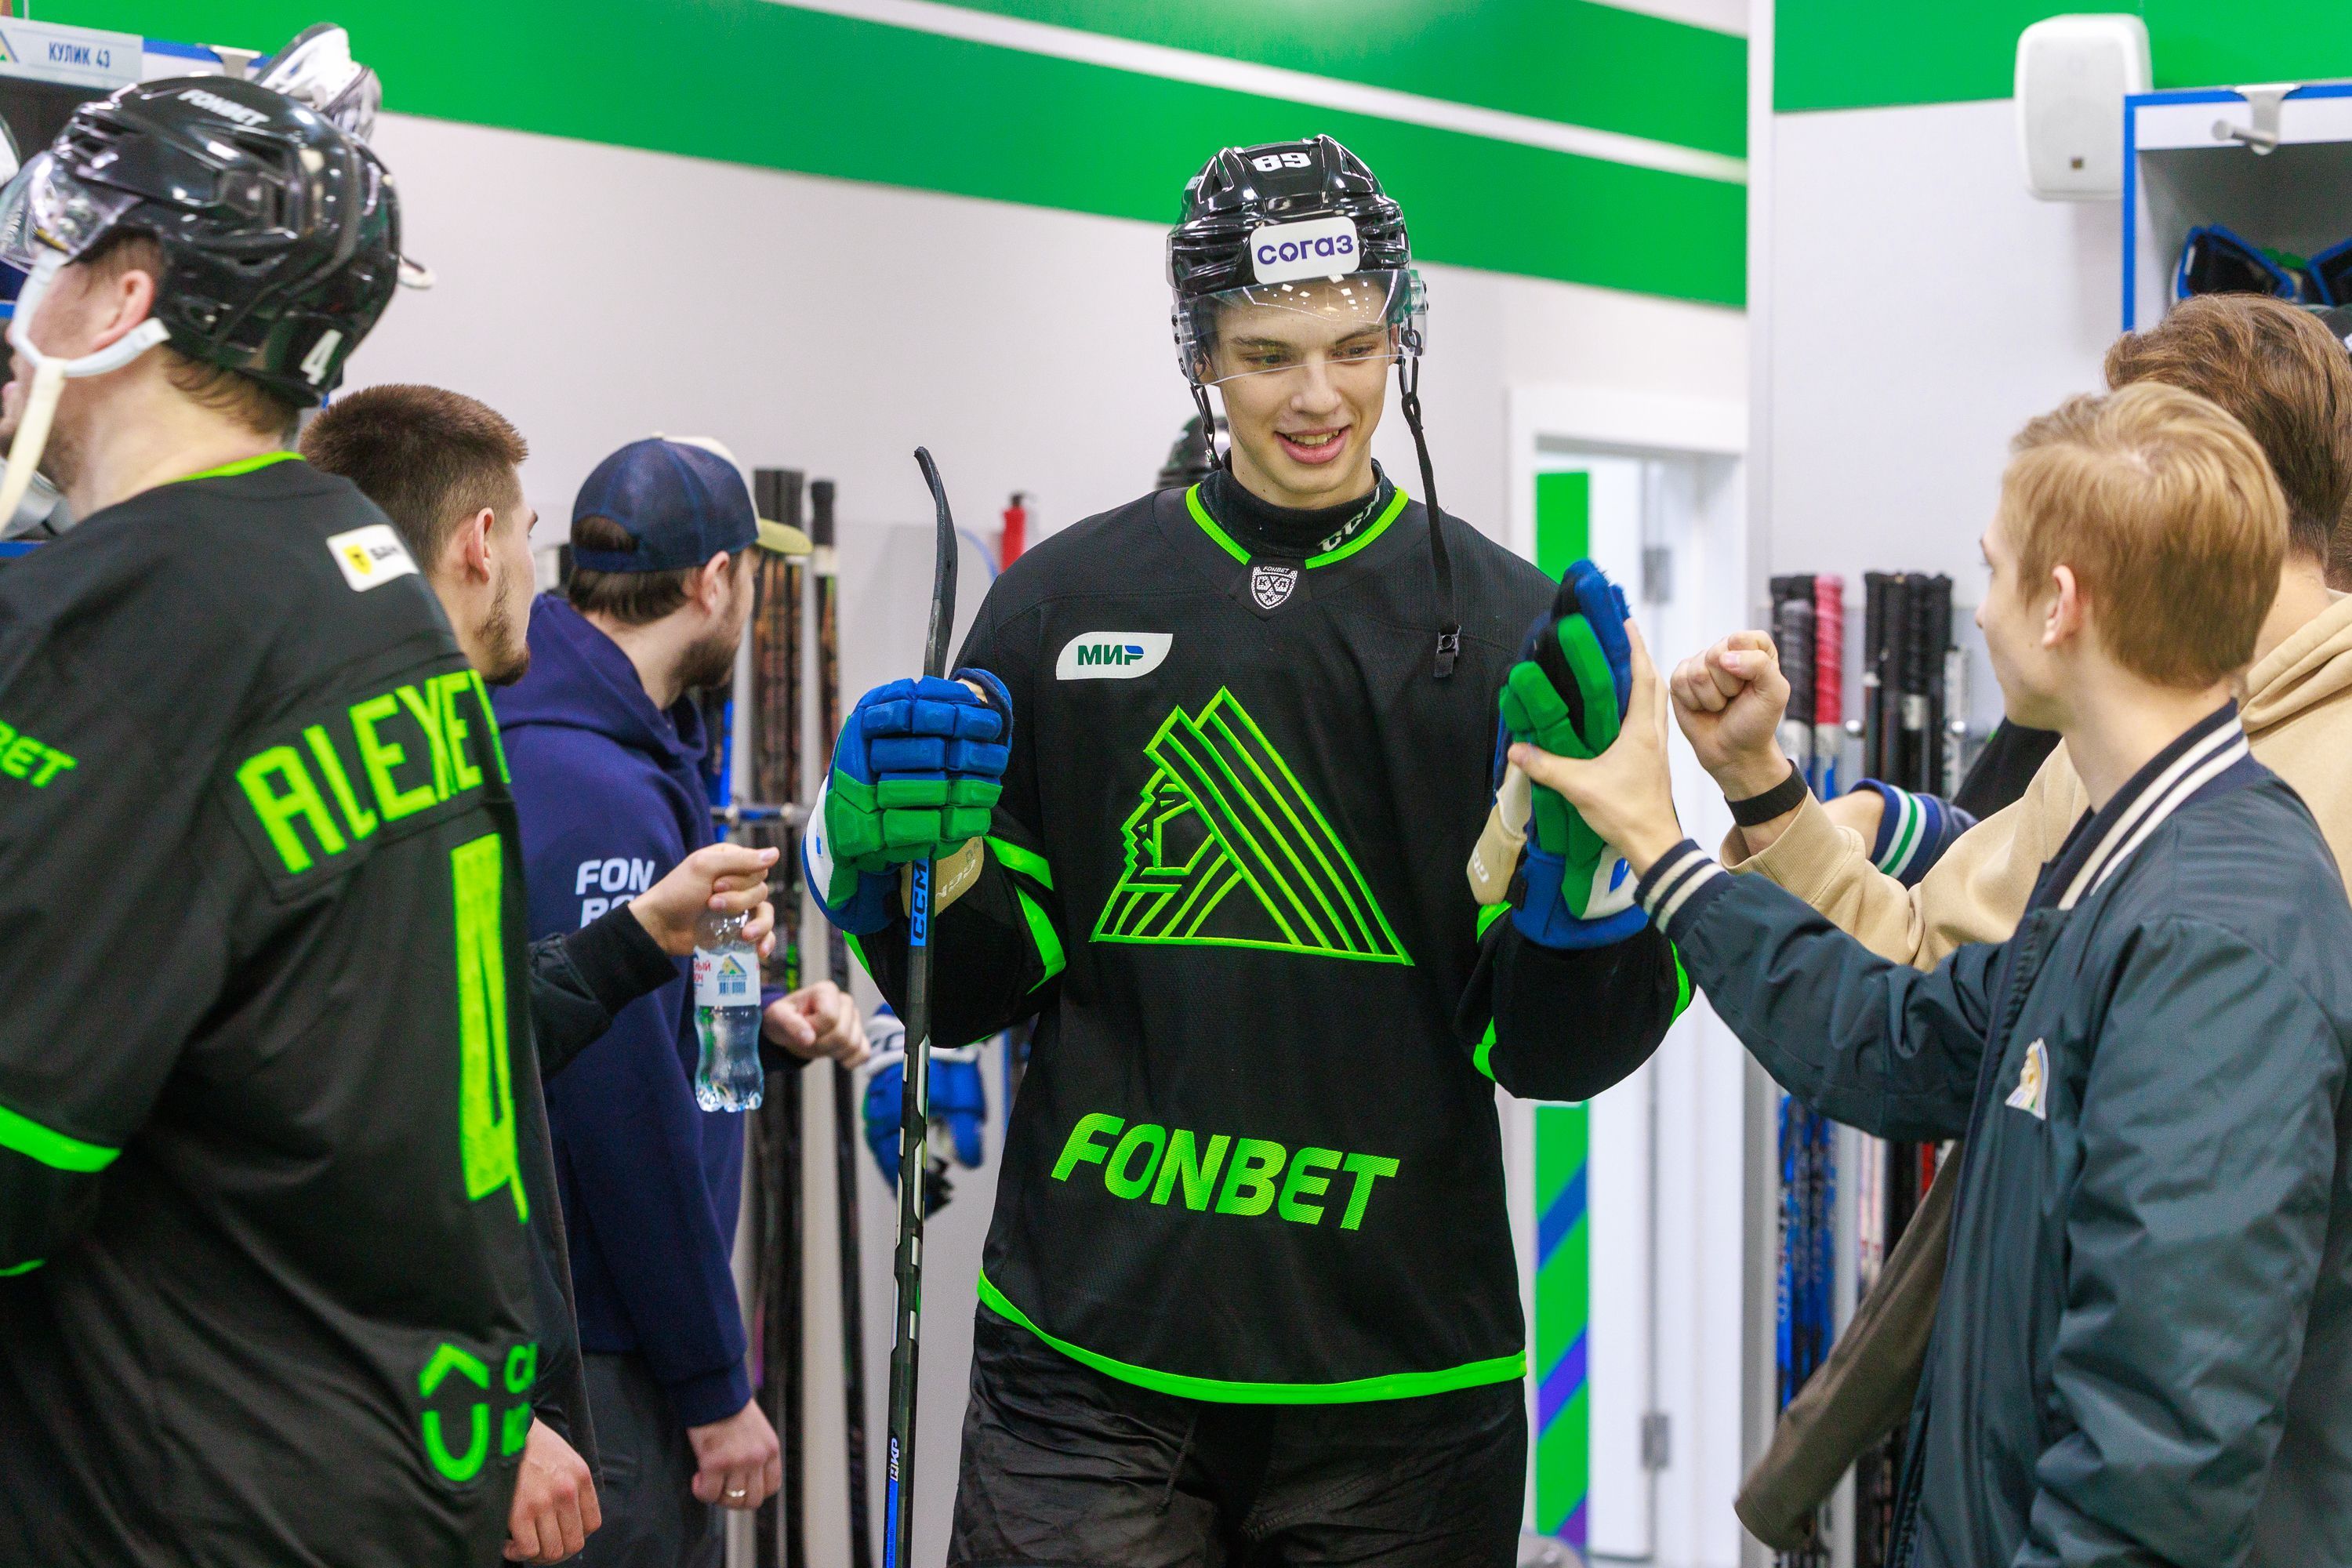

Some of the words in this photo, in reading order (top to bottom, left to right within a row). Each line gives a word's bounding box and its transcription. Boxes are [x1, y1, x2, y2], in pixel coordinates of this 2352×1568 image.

[49, 42, 91, 66] КУЛИК
[96, 49, 111, 69] 43
[1252, 152, 1312, 172] 89
[299, 328, 343, 385] 4
[1077, 644, 1145, 666] МИР
[913, 863, 927, 940] CCM
[1051, 1112, 1400, 1231] FONBET
